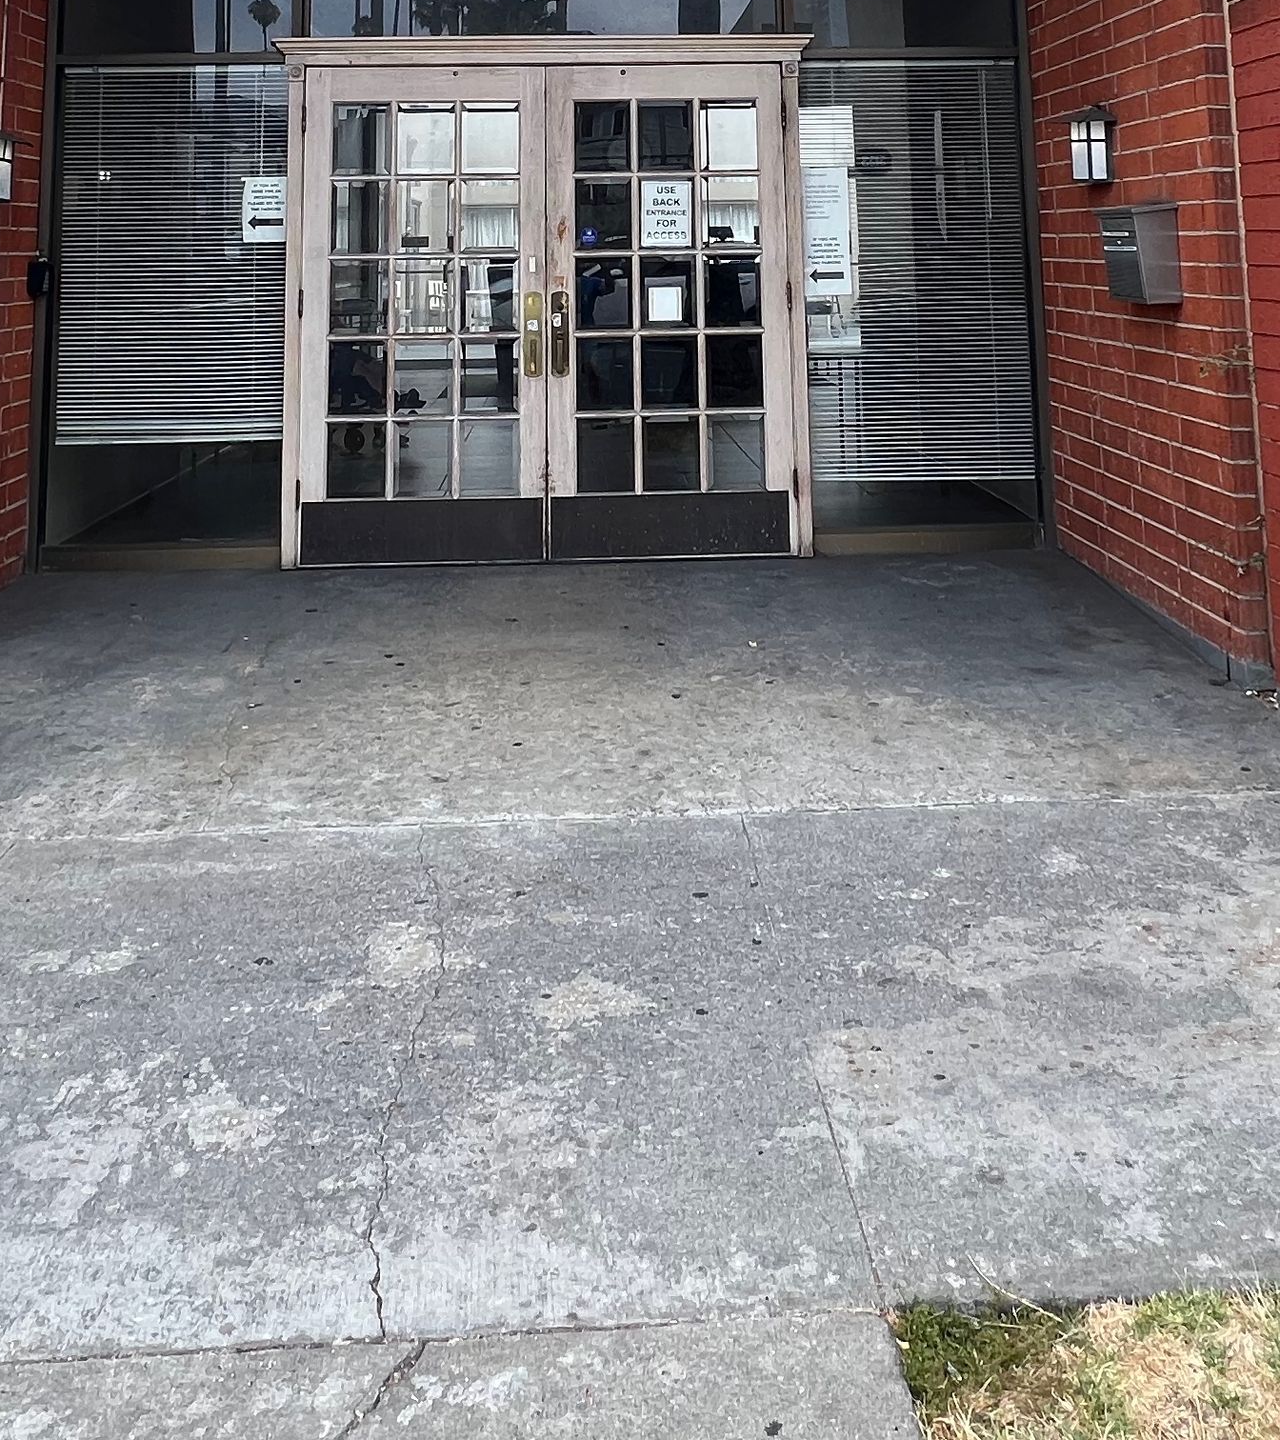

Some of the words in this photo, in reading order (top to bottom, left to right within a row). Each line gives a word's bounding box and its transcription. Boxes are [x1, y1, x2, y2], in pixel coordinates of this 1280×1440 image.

[656, 186, 677, 195] USE
[652, 198, 681, 207] BACK
[656, 219, 677, 228] FOR
[646, 231, 688, 240] ACCESS
